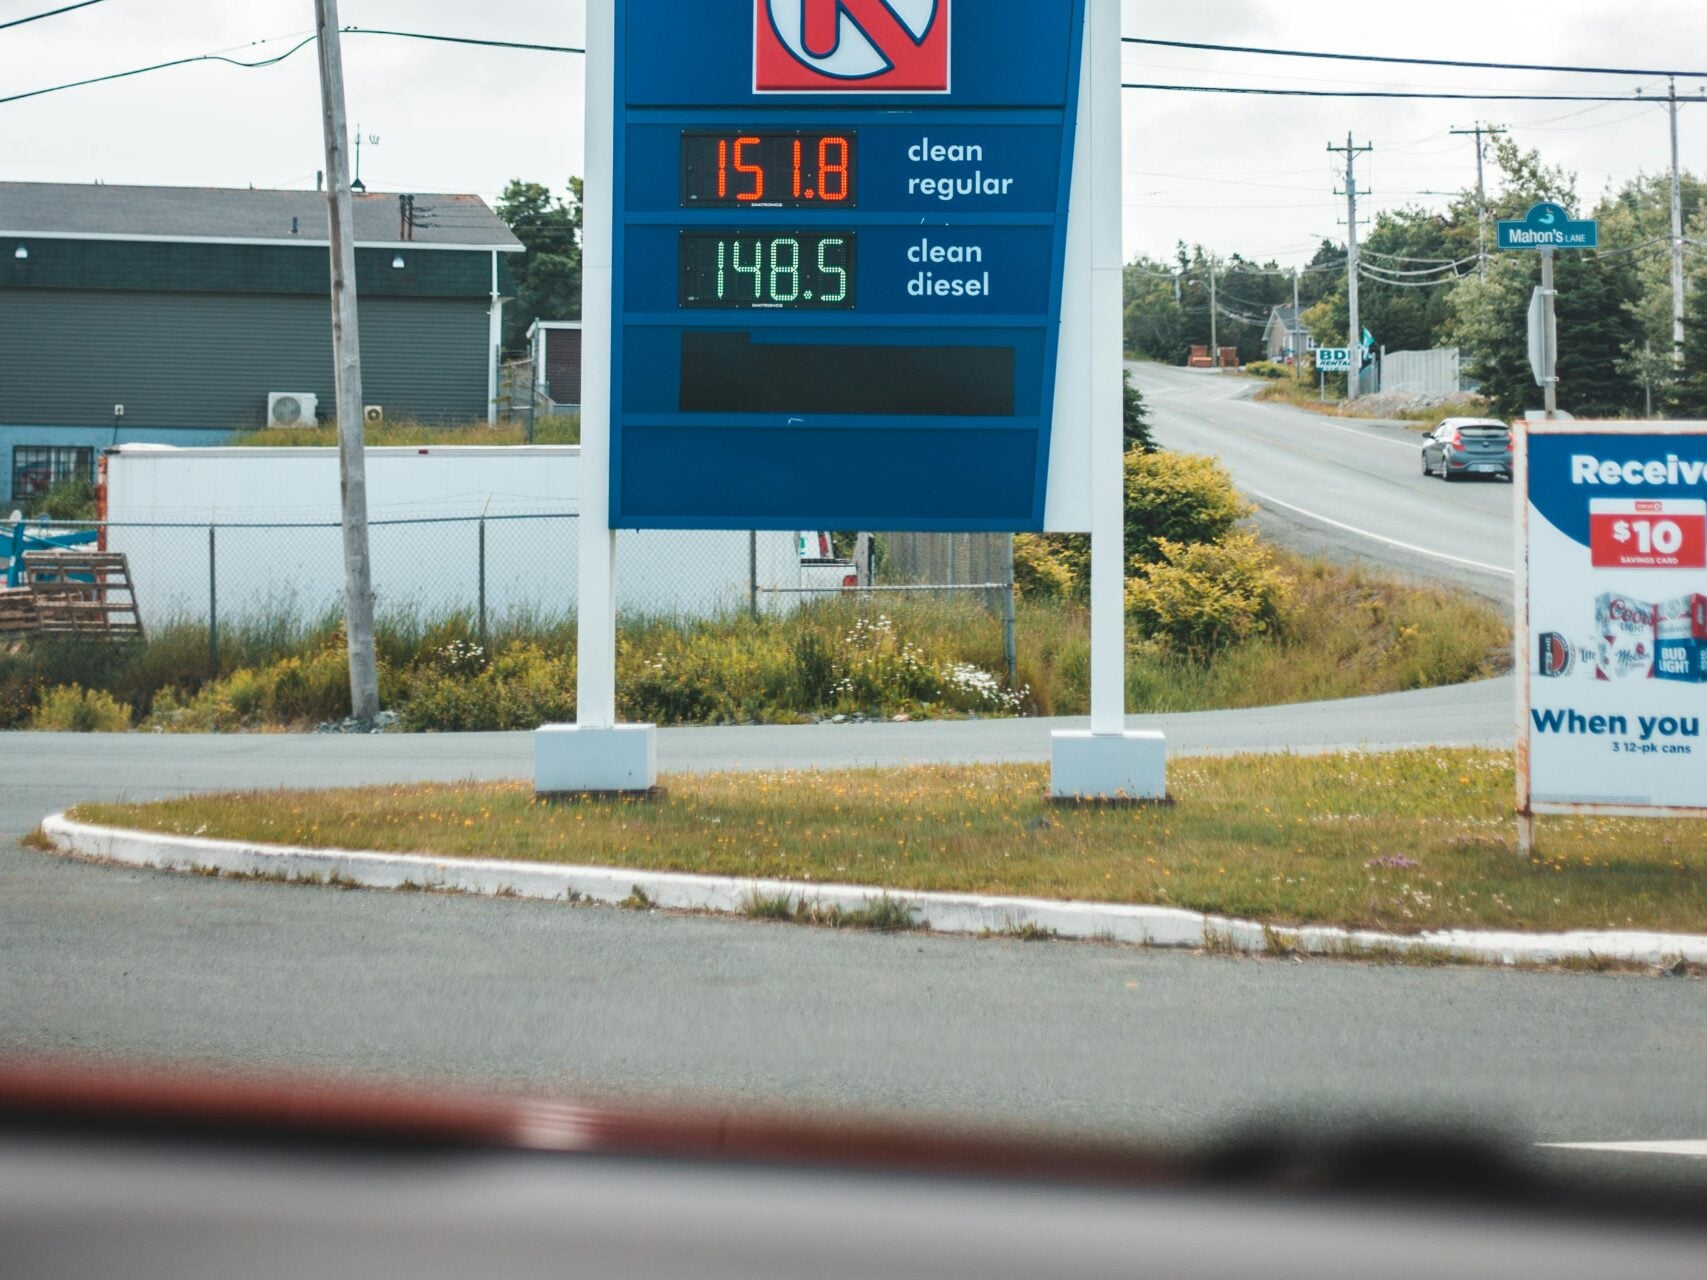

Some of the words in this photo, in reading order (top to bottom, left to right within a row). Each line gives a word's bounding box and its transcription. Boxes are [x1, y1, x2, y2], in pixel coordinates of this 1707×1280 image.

[907, 137, 983, 163] clean
[717, 137, 848, 201] 151.8
[907, 170, 1014, 201] regular
[1508, 228, 1564, 244] Mahon's
[1565, 234, 1586, 243] LANE
[907, 238, 982, 264] clean
[717, 238, 847, 302] 148.5
[907, 270, 990, 298] diesel
[1571, 454, 1707, 485] Receiv
[1612, 520, 1683, 554] $10
[1620, 556, 1655, 565] SAVINGS
[1656, 557, 1679, 565] CARD
[1659, 659, 1690, 674] LIGHT
[1661, 647, 1687, 659] BUD
[1531, 708, 1627, 735] When
[1638, 716, 1700, 741] you
[1612, 742, 1620, 752] 3
[1624, 742, 1658, 754] 12-pk
[1662, 744, 1692, 754] cans
